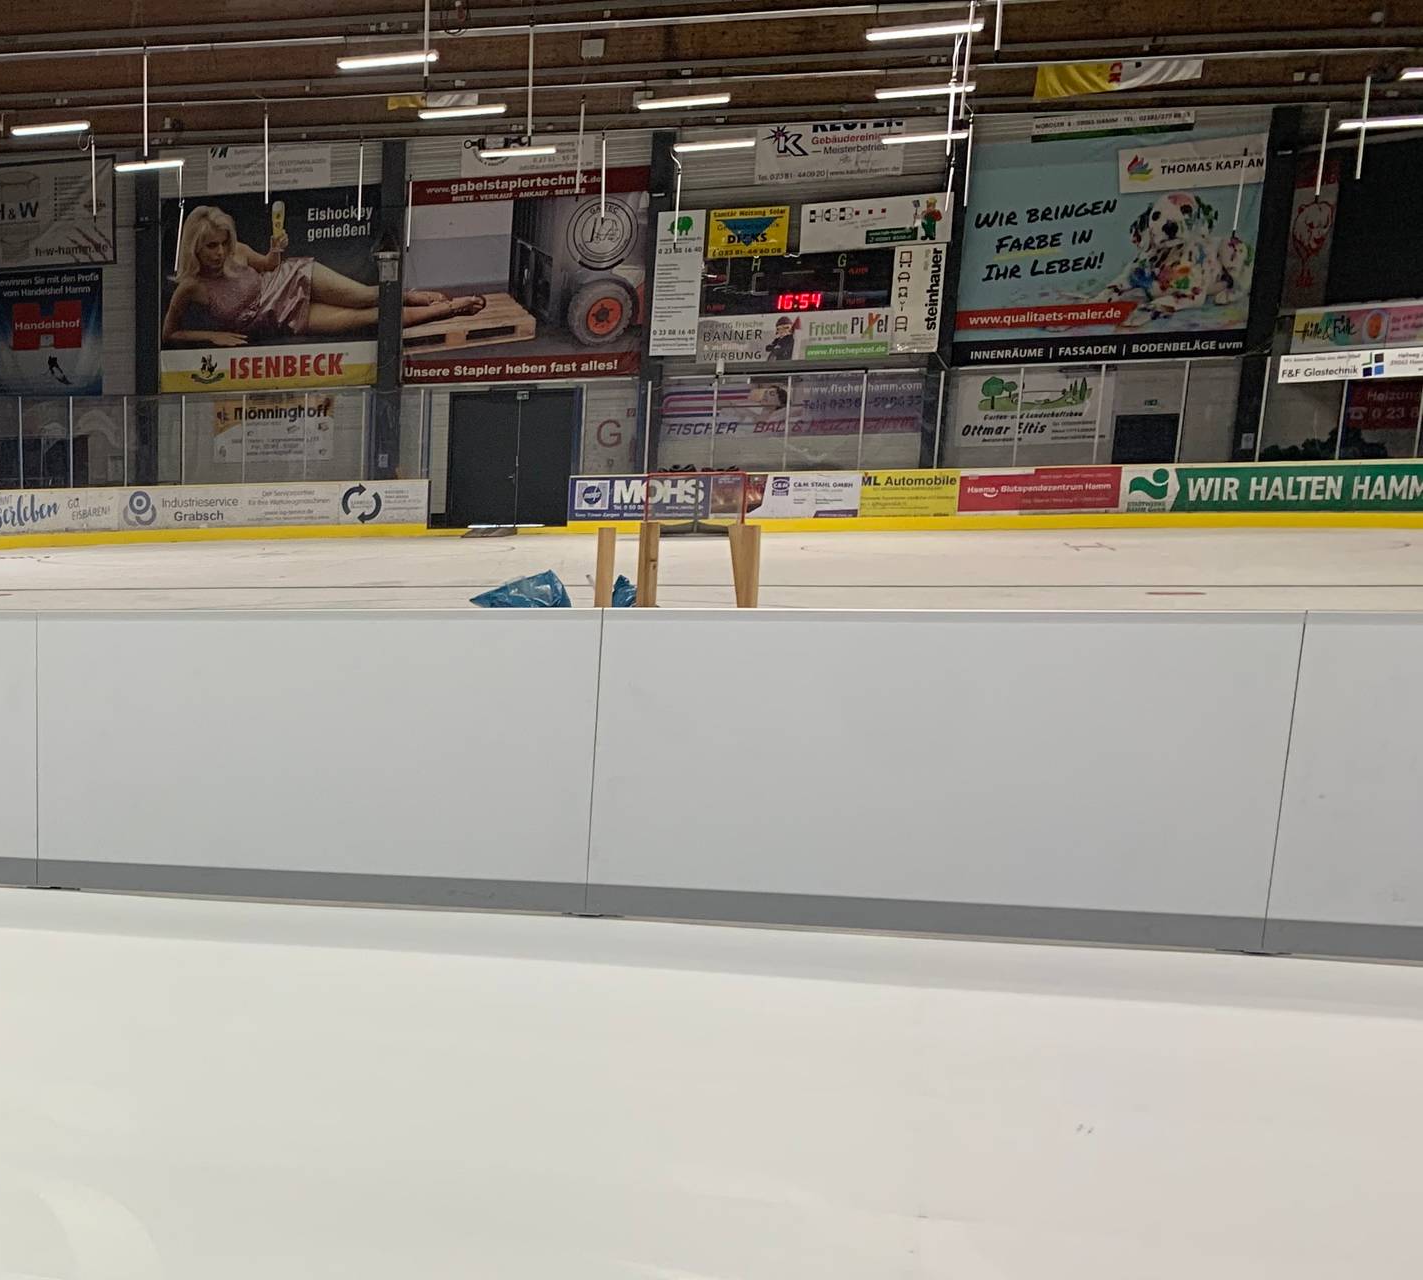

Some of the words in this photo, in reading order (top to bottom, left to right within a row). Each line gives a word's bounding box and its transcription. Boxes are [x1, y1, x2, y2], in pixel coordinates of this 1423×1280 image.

[1161, 161, 1212, 175] THOMAS
[1216, 157, 1265, 172] KAPLAN
[426, 173, 602, 196] www.gabelstaplertechnk.de
[452, 194, 474, 202] MIETE
[480, 191, 513, 201] VERKAUF
[519, 190, 549, 199] ANKAUF
[8, 208, 17, 220] &
[18, 201, 39, 218] W
[307, 205, 373, 222] Eishockey
[974, 210, 1018, 230] WIR
[1027, 198, 1118, 224] BRINGEN
[307, 222, 371, 242] genießen!
[995, 233, 1063, 254] FARBE
[1071, 229, 1094, 245] IN
[751, 258, 761, 272] H
[982, 263, 1022, 283] IHR
[1030, 251, 1105, 277] LEBEN!
[33, 276, 46, 285] Sie
[47, 275, 60, 284] mit
[61, 274, 76, 283] den
[77, 273, 99, 283] Profis
[2, 290, 19, 298] vom
[21, 286, 64, 297] Handelshof
[65, 285, 91, 294] Hamm
[925, 247, 943, 331] steinhauer
[777, 293, 822, 311] 16:54
[14, 319, 81, 331] Handelshof
[968, 308, 1122, 326] www.qualitaets-maler.de
[703, 329, 762, 342] BANNER
[809, 321, 848, 337] Frische
[703, 351, 762, 361] WERBUNG
[970, 346, 1044, 360] INNENRÄUME
[1058, 344, 1118, 357] FASSADEN
[1132, 339, 1217, 354] BODENBELÄGE
[1218, 341, 1243, 351] uvm
[229, 353, 345, 380] ISENBECK
[404, 366, 450, 378] Unsere
[453, 363, 503, 379] Stapler
[505, 362, 547, 374] heben
[550, 361, 577, 373] fast
[580, 359, 619, 372] alles!
[1281, 368, 1301, 378] F&F
[1304, 365, 1358, 378] Glastechnik
[803, 382, 922, 395] www.fischerhamm.com
[233, 404, 328, 423] mönninghoff
[596, 419, 622, 447] G
[667, 421, 739, 435] FISCHER
[961, 423, 1011, 437] Ottmar
[861, 475, 881, 486] ML
[884, 475, 957, 486] Automobile
[1000, 484, 1084, 494] Blutspendezentrum
[1085, 482, 1112, 490] Hamm
[1187, 476, 1240, 502] WIR
[1249, 475, 1342, 501] HALTEN
[613, 479, 705, 504] MOHS
[161, 496, 239, 509] Industrieservice
[173, 509, 224, 522] Grabsch
